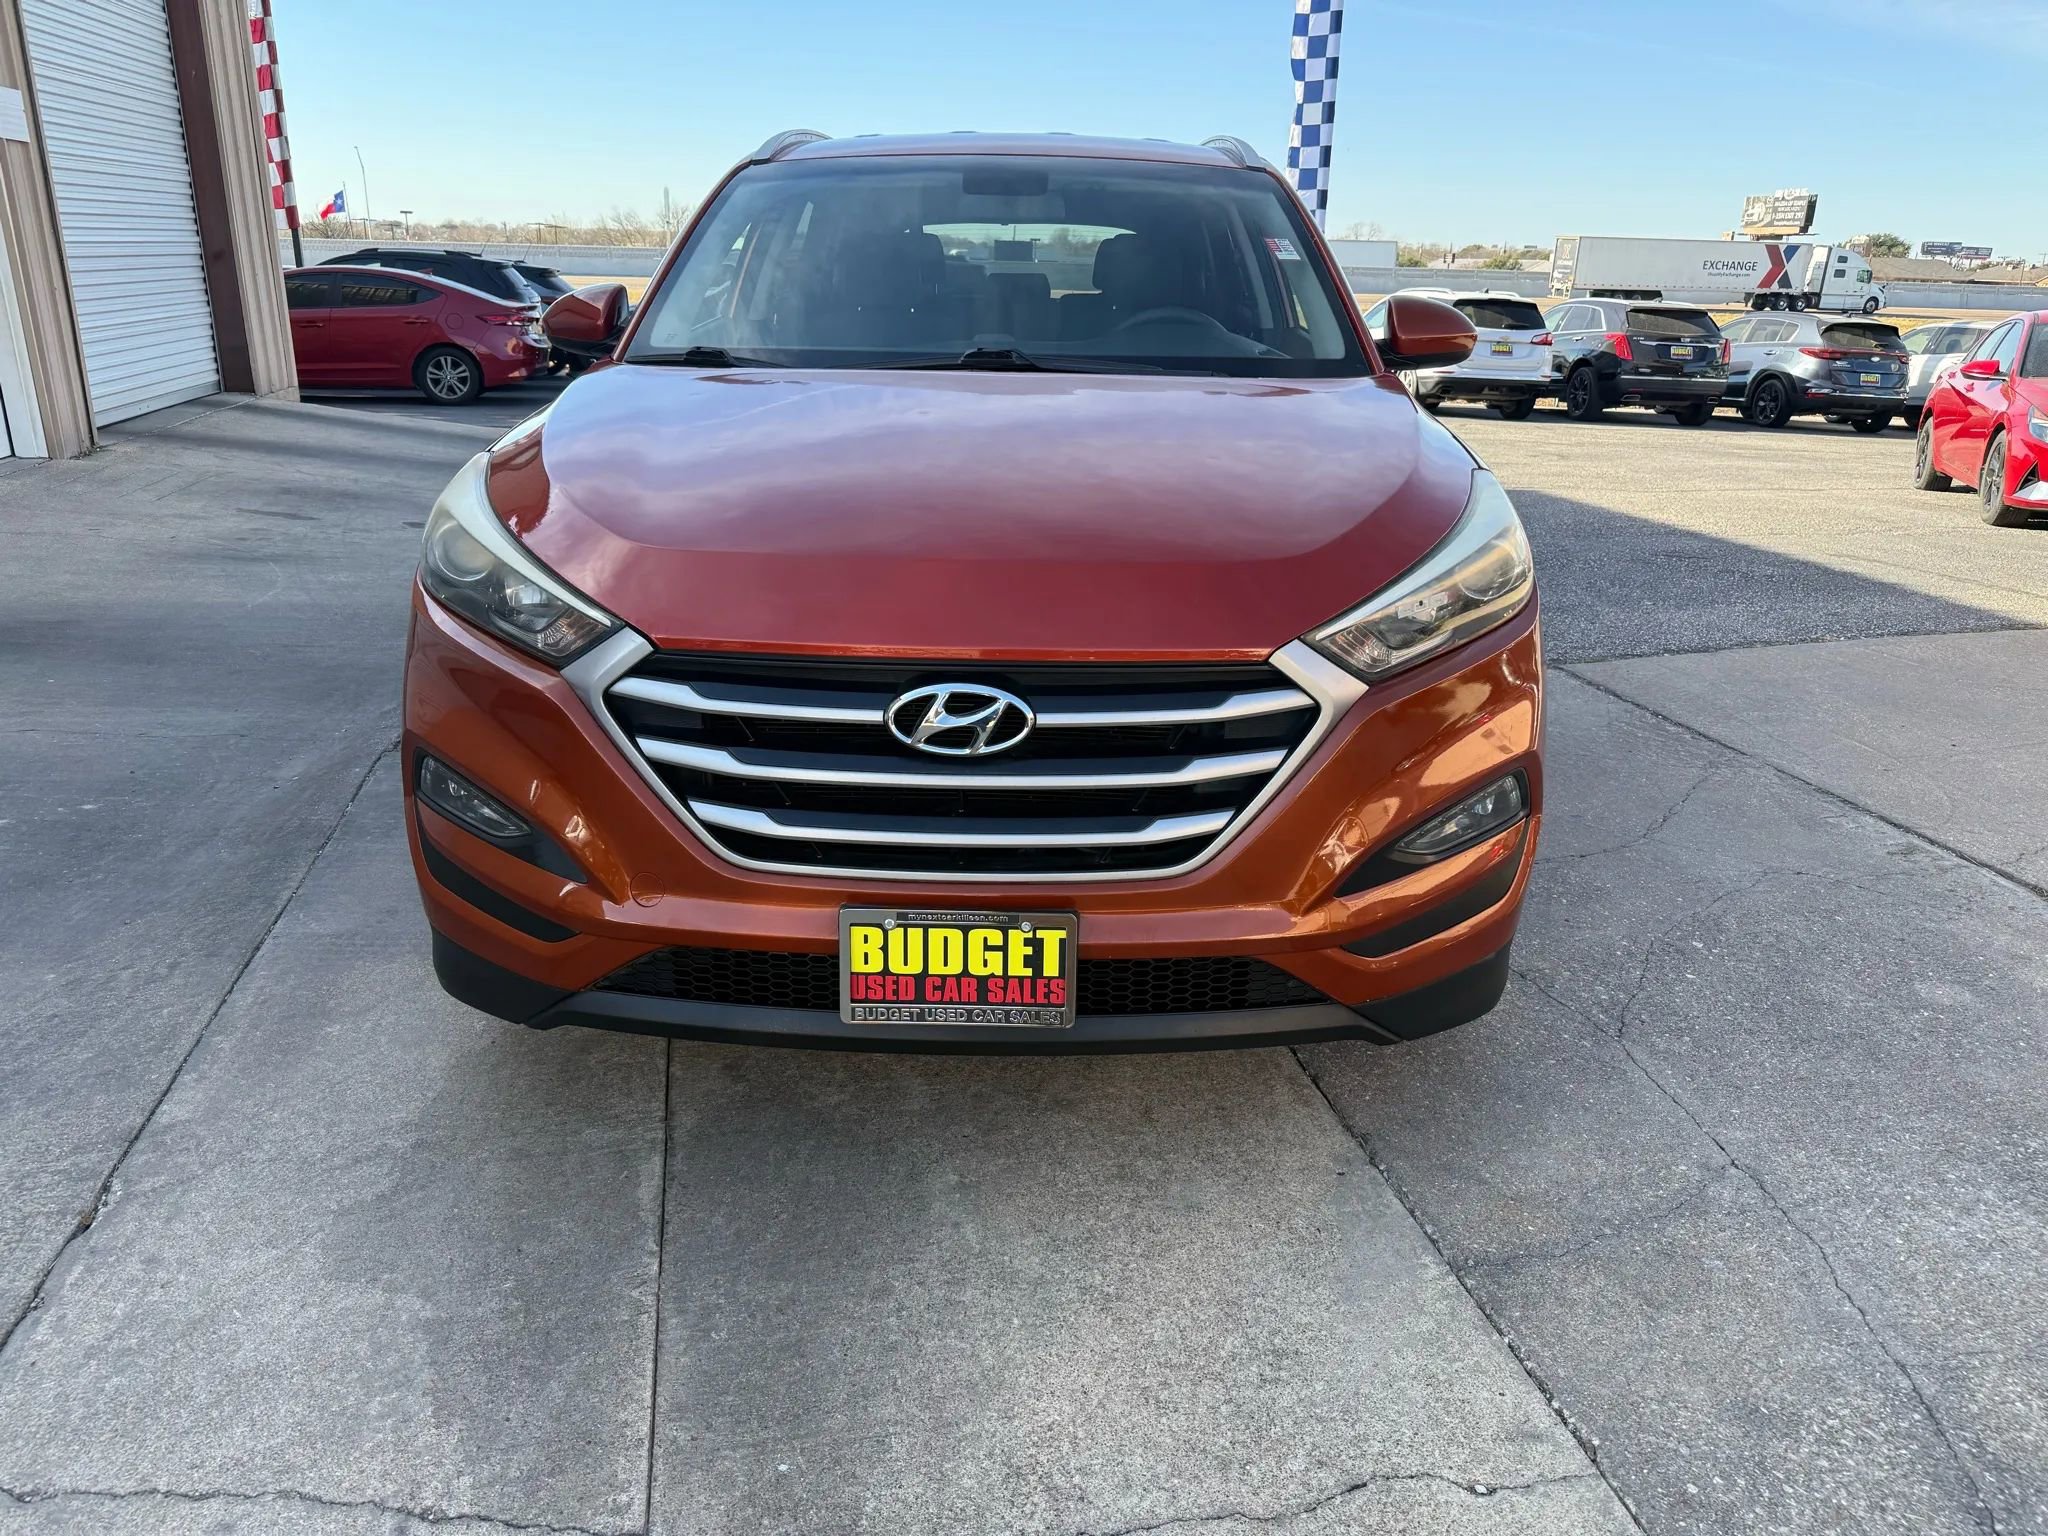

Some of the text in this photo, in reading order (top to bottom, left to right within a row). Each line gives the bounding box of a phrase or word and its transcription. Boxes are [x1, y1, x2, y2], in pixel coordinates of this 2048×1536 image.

[1703, 260, 1758, 271] EXCHANGE
[850, 926, 1067, 977] BUDGET
[850, 975, 1066, 1005] USED CAR SALES
[854, 1007, 1061, 1025] BUDGET USED CAR SALES
